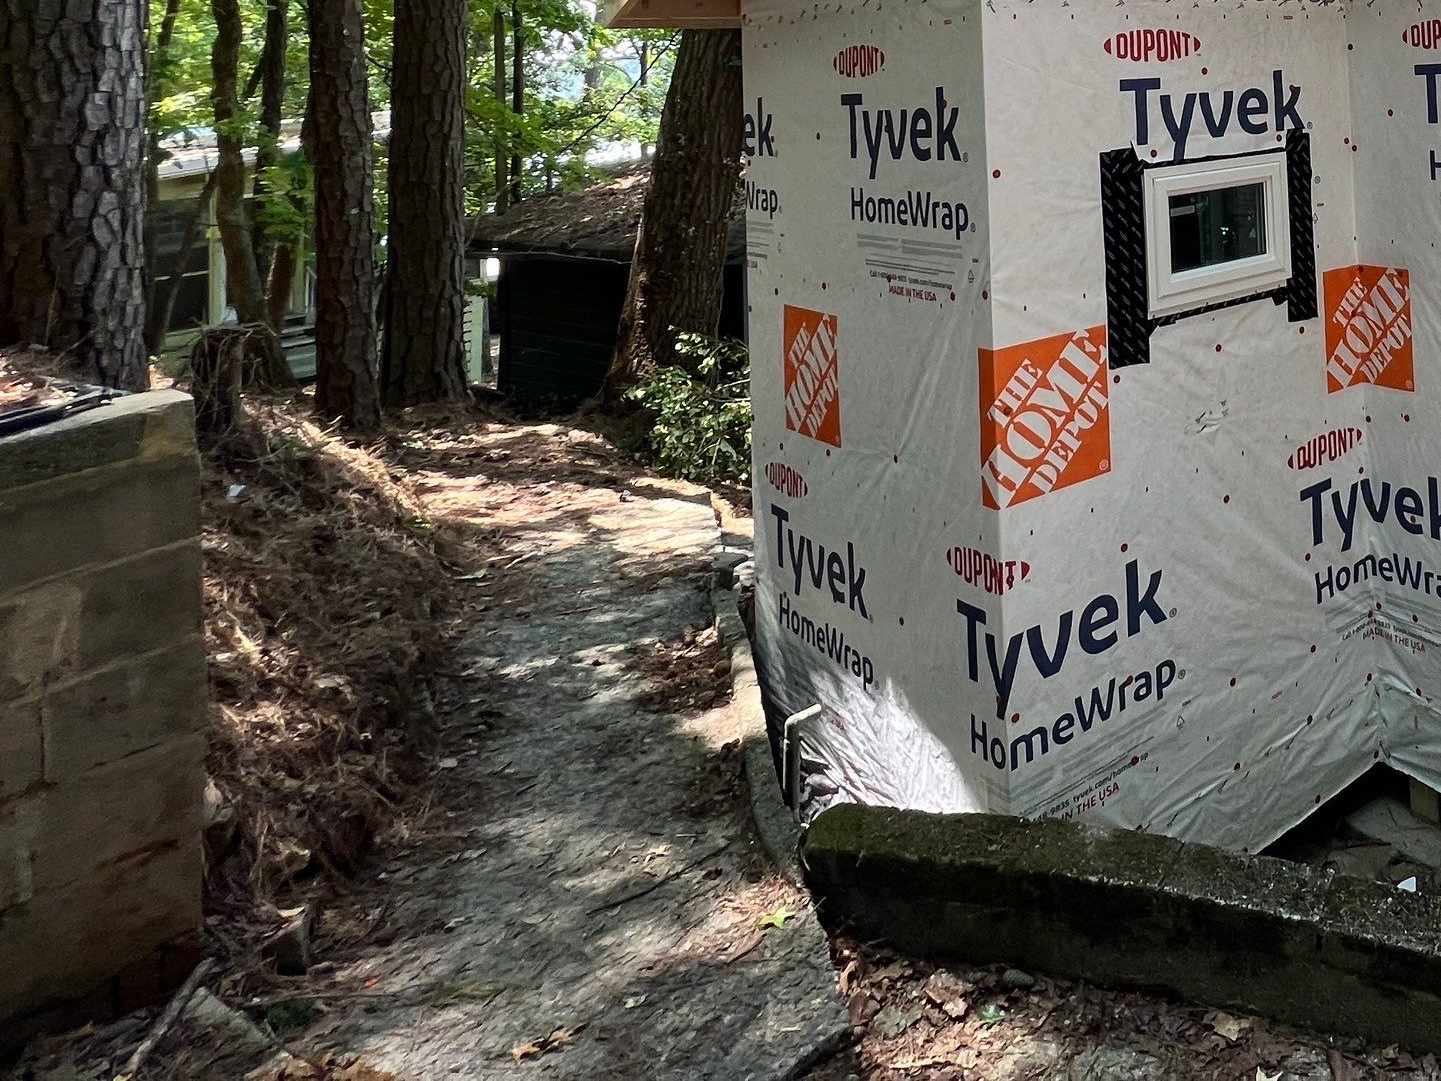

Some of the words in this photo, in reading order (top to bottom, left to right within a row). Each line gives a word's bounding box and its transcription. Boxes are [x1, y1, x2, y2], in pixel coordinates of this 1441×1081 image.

[839, 45, 879, 78] DUPONT
[1116, 29, 1191, 62] DUPONT
[841, 86, 961, 179] Tyvek
[1119, 69, 1306, 163] Tyvek
[850, 186, 969, 240] HomeWrap
[1326, 267, 1410, 389] HOME
[981, 328, 1109, 509] HOME
[987, 358, 1043, 428] THE
[1028, 381, 1108, 494] DEPOT
[1297, 427, 1355, 469] DUPONT
[769, 461, 804, 500] DUPONT
[770, 503, 869, 620] Tyvek
[954, 547, 1017, 596] DUPONT
[779, 593, 875, 690] HomeWrap
[956, 558, 1168, 720] Tyvek
[1394, 631, 1409, 648] THE
[1410, 640, 1426, 654] USA
[968, 658, 1177, 773] HomeWrap
[1076, 795, 1097, 814] THE
[1099, 781, 1120, 802] USA
